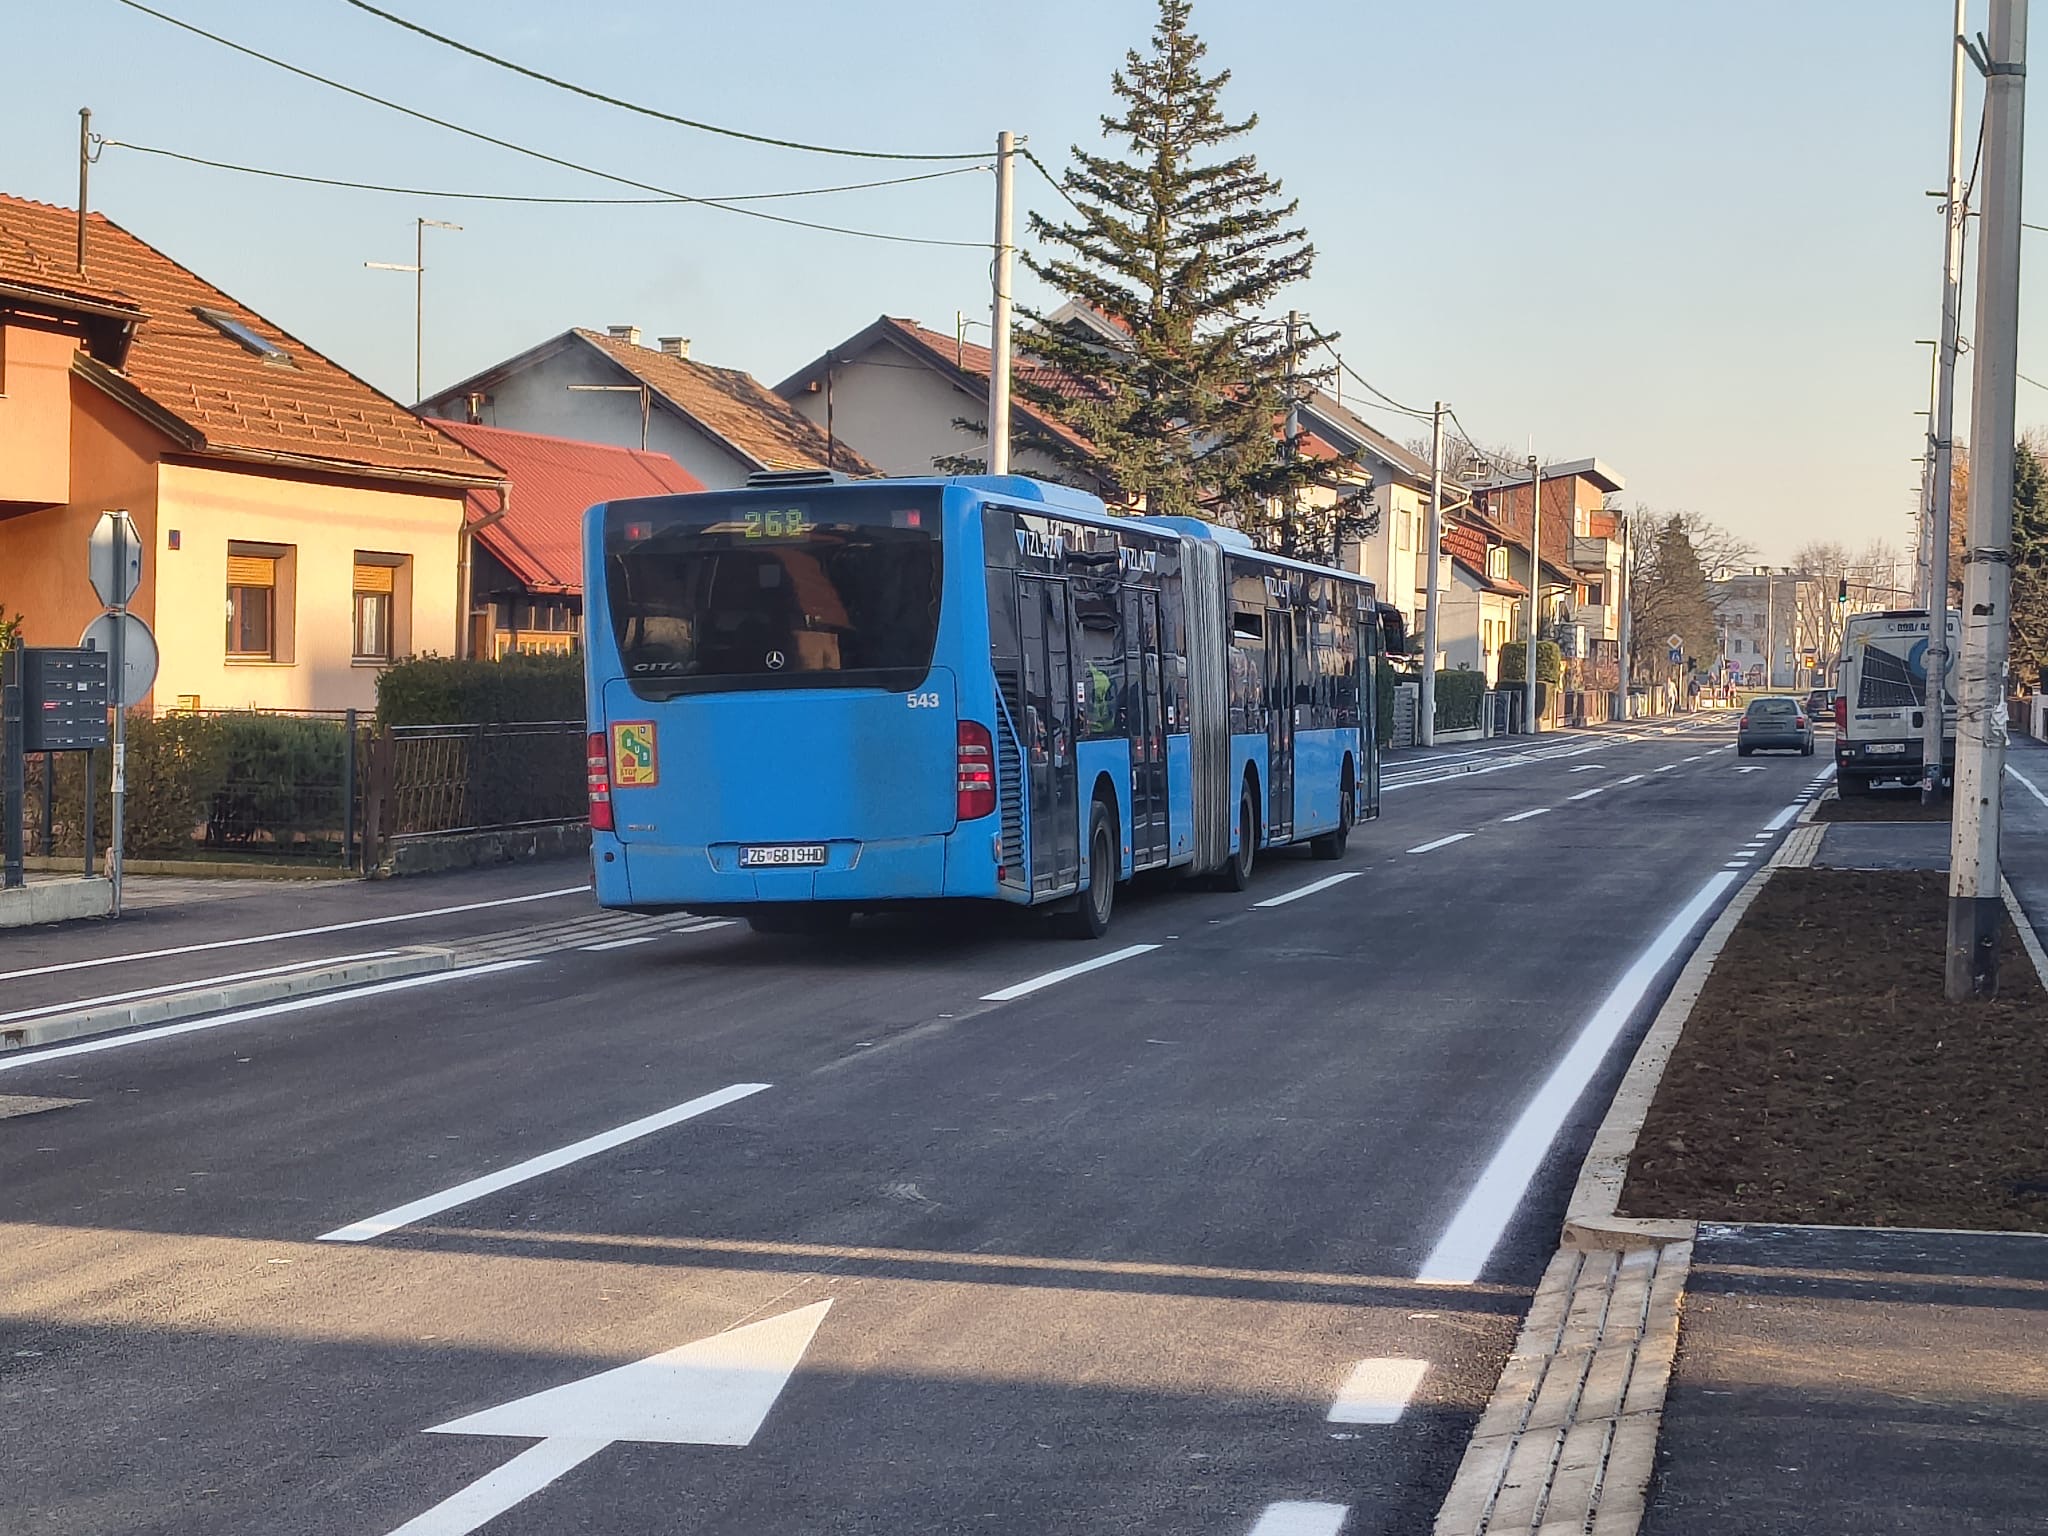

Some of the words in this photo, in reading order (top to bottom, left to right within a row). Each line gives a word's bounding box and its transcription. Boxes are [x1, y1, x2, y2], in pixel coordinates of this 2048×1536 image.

[745, 509, 802, 538] 268
[1025, 529, 1056, 559] IZLAZ
[1127, 547, 1151, 573] IZLAZ
[906, 692, 940, 709] 543
[750, 849, 766, 863] ZG
